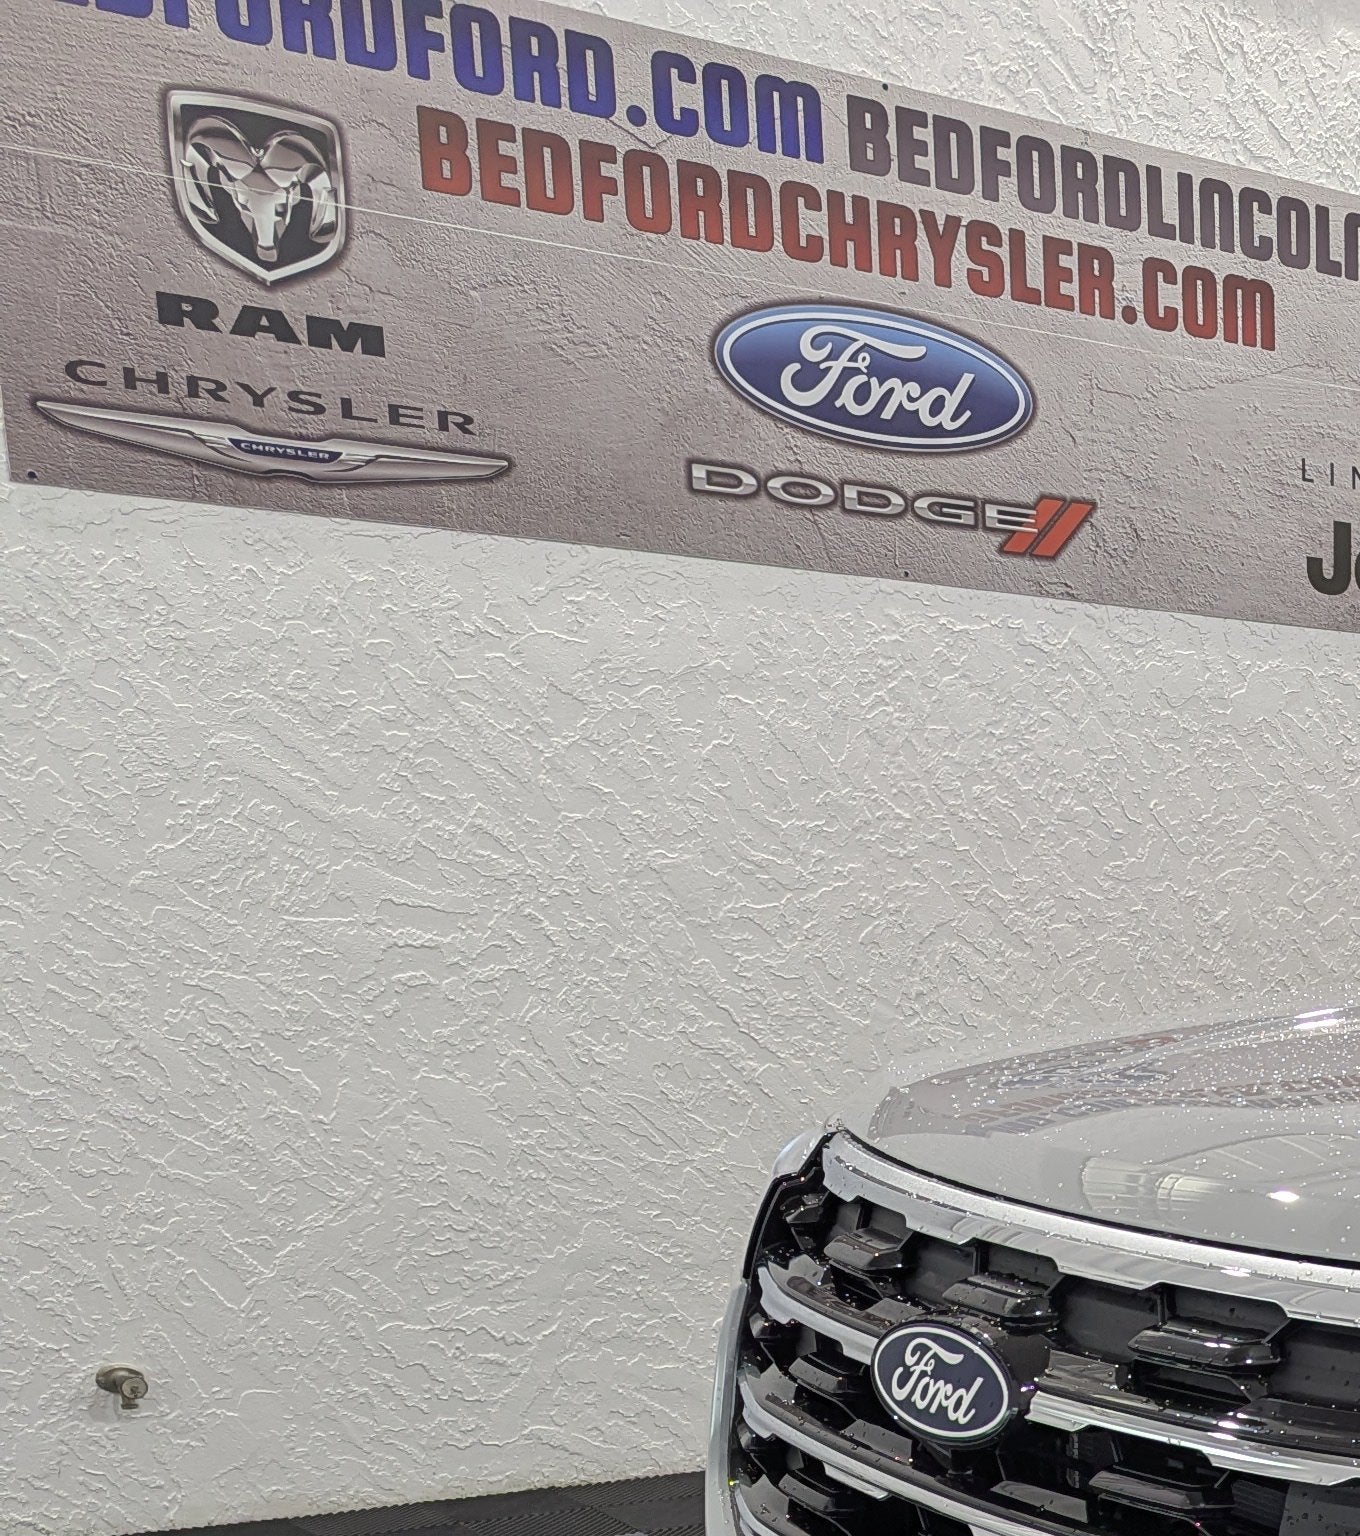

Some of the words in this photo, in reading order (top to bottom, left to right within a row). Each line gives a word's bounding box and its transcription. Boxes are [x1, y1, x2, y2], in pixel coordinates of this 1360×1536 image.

[416, 104, 1276, 352] BEDFORDCHRYSLER.COM
[154, 290, 386, 358] RAM
[64, 358, 477, 437] CHRYSLER
[779, 324, 977, 431] Ford
[240, 442, 330, 460] CHRYSLER
[690, 462, 1039, 534] DODGE
[891, 1337, 984, 1424] Ford
